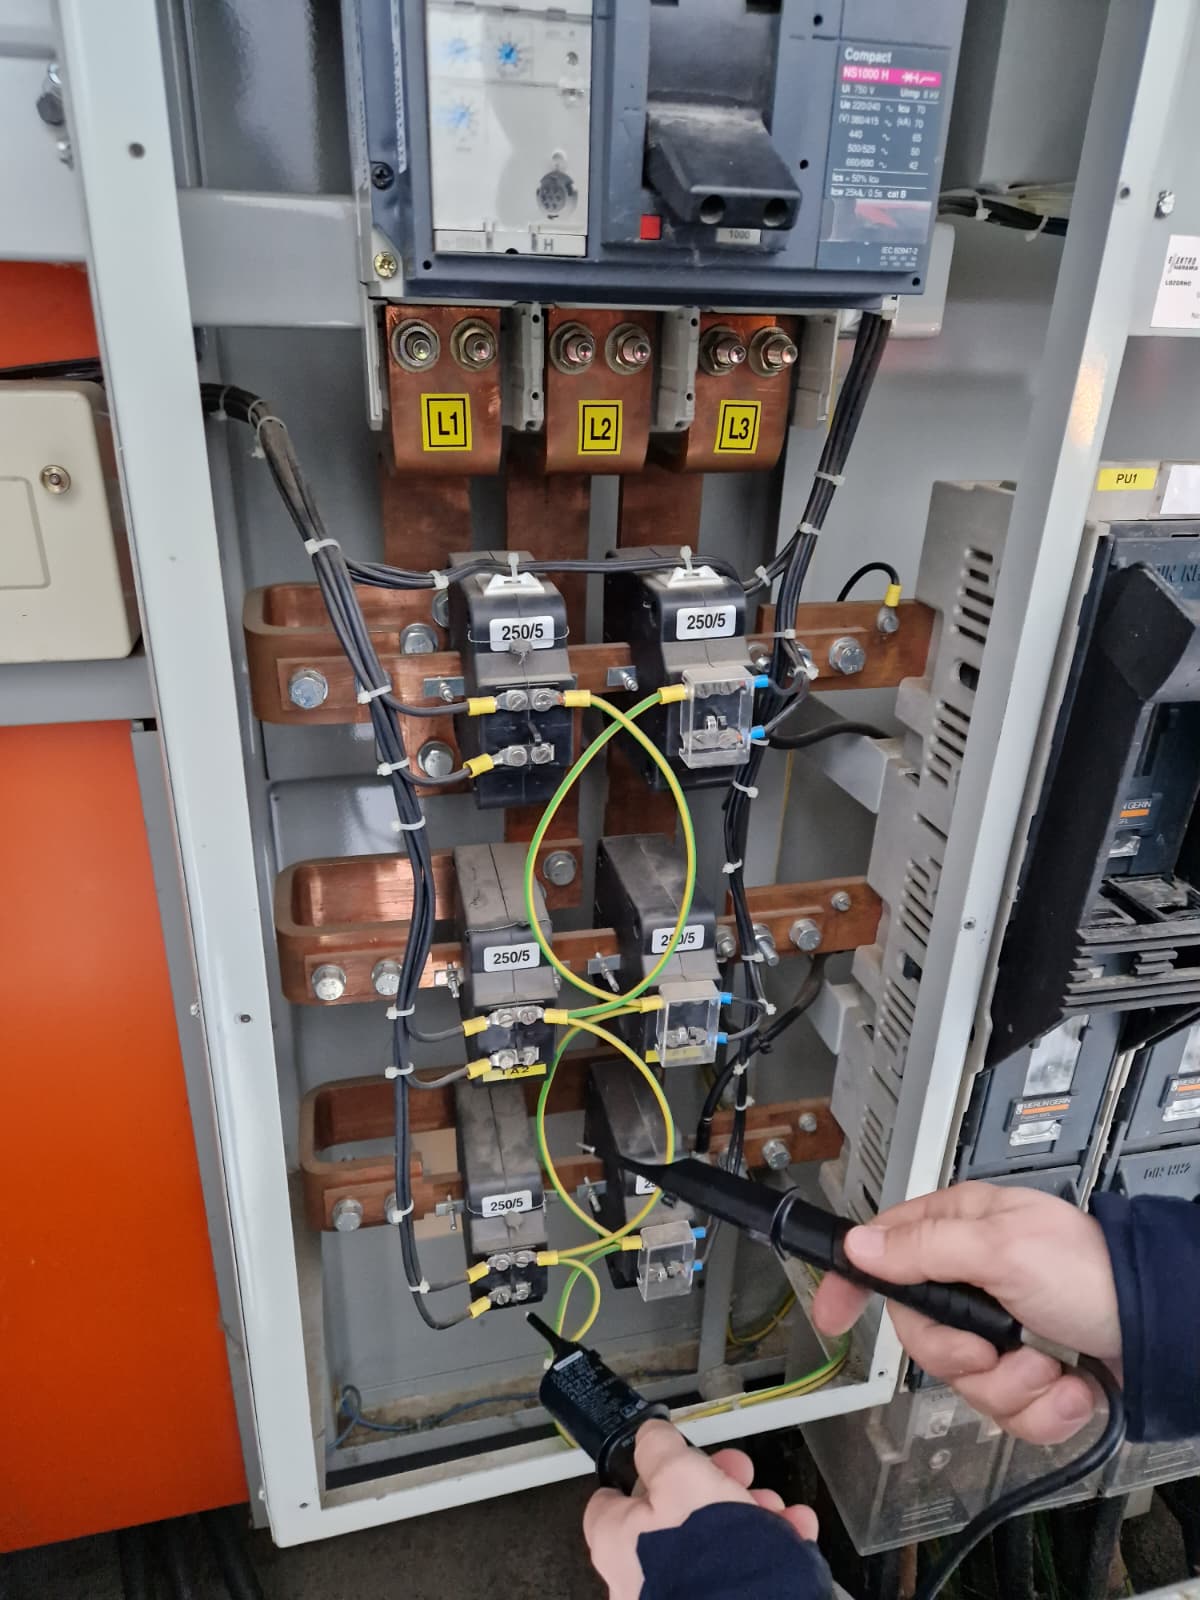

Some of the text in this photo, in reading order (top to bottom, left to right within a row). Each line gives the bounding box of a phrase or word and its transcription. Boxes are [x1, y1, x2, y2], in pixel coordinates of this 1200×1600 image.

[844, 47, 892, 64] Compact
[843, 65, 890, 81] NS1000 H
[869, 86, 875, 95] V
[917, 105, 926, 114] 70
[839, 113, 850, 124] (V)
[915, 119, 924, 129] 70
[848, 129, 863, 139] 440
[851, 174, 867, 183] 50%
[900, 190, 907, 199] B
[729, 229, 751, 239] 1000
[543, 239, 554, 252] H
[881, 246, 893, 254] IEC
[437, 411, 459, 436] L1
[589, 416, 611, 440] L2
[728, 416, 749, 440] L3
[1116, 473, 1138, 484] PU1
[686, 613, 726, 630] 250/5
[502, 622, 544, 641] 250/5
[493, 949, 530, 965] 250/5
[490, 1197, 524, 1212] 250/5
